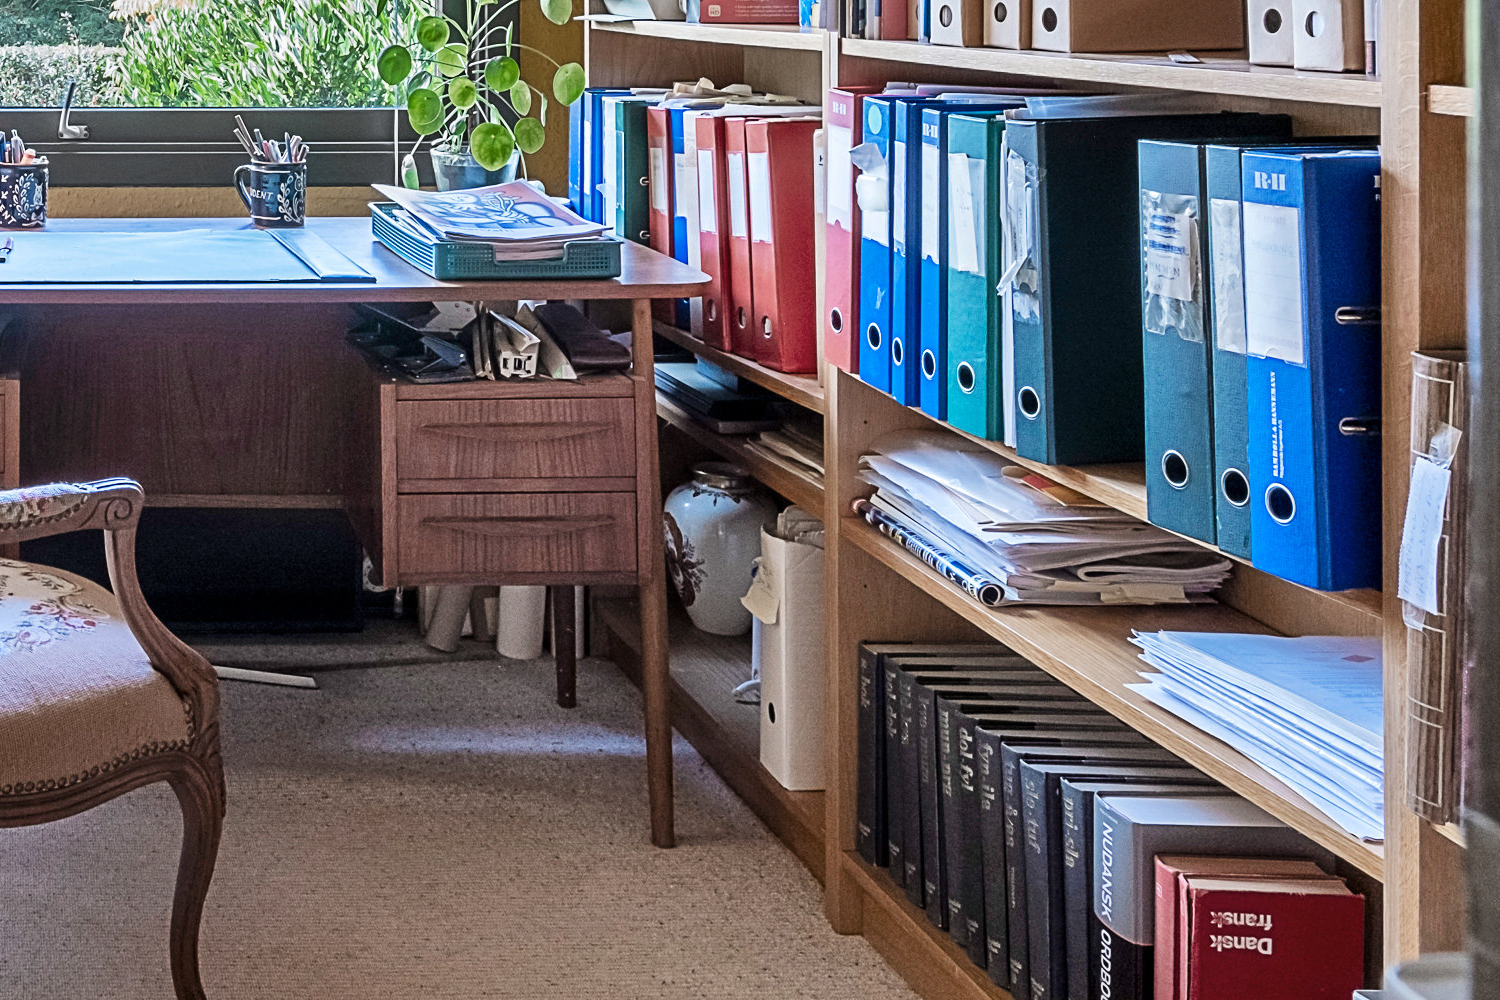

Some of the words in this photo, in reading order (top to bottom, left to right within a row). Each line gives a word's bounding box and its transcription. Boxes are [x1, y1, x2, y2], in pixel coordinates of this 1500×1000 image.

[959, 727, 974, 792] dol-fyl
[1101, 820, 1114, 922] NUDANSK
[1210, 911, 1273, 931] fransk
[1210, 934, 1273, 955] Dansk
[1100, 928, 1112, 1000] ORDBO
